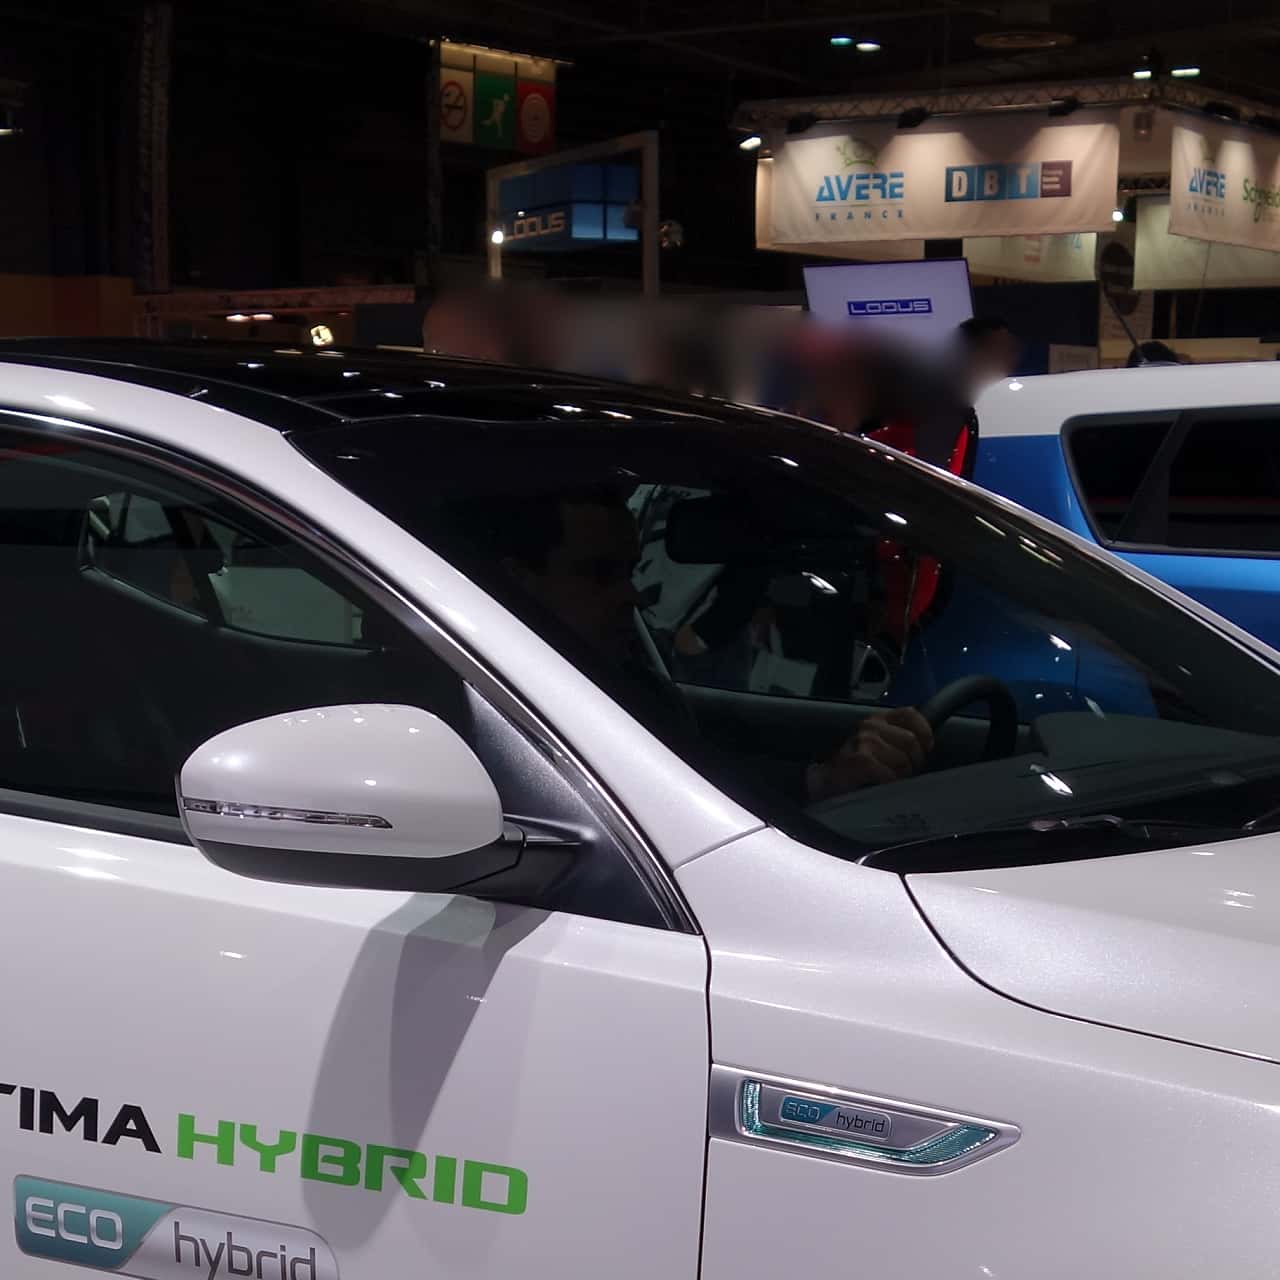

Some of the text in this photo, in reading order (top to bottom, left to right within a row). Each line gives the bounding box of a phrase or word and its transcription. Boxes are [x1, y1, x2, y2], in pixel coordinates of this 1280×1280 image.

[815, 172, 905, 202] AVERE
[1188, 167, 1226, 199] AVERE
[815, 209, 904, 221] FRANCE
[786, 1101, 886, 1133] ECO hybrid
[177, 1113, 529, 1215] HYBRID
[25, 1196, 123, 1251] ECO
